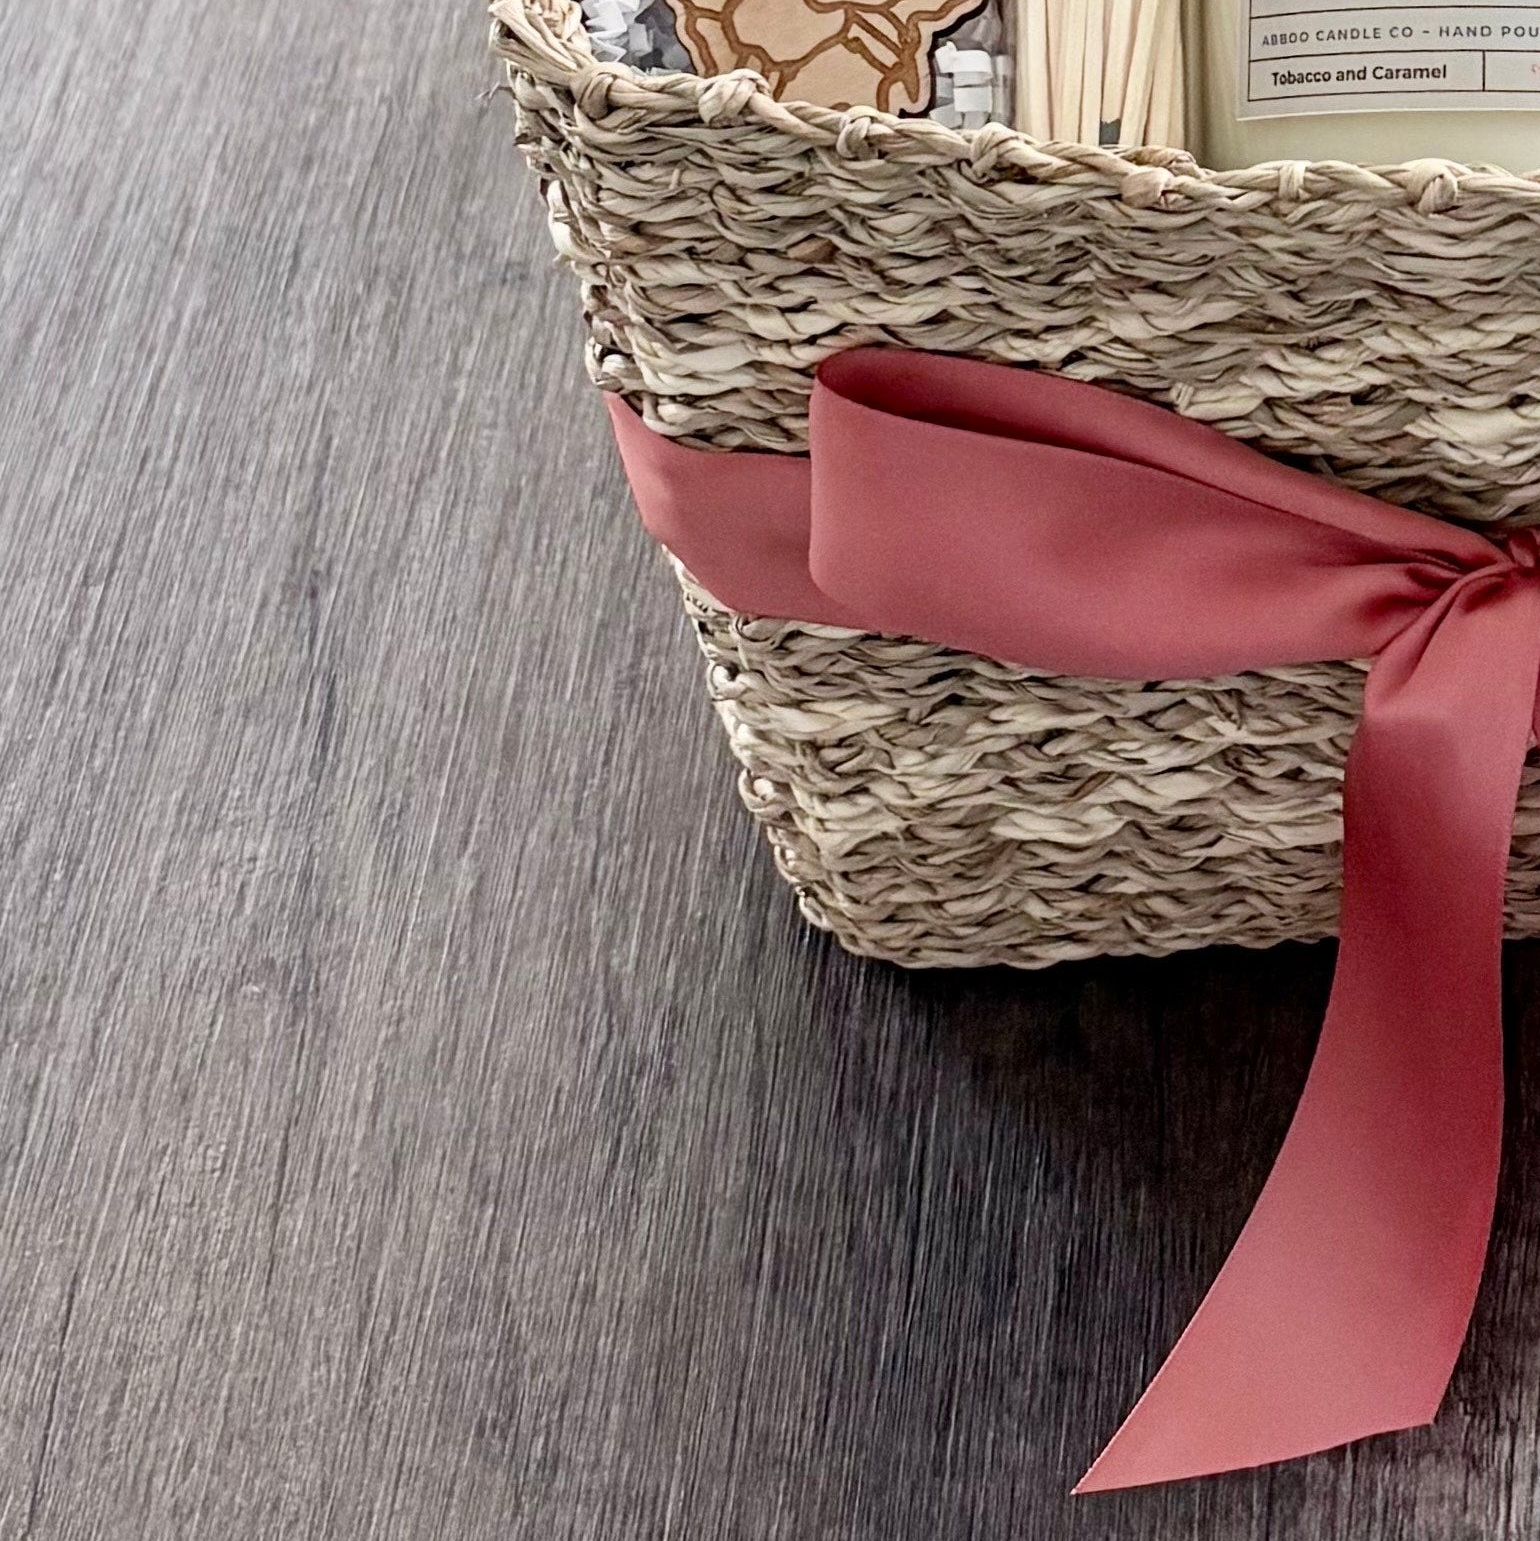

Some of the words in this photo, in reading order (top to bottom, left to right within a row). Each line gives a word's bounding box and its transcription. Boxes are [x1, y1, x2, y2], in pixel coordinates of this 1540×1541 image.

[1316, 27, 1382, 42] CANDLE
[1389, 26, 1413, 38] CO
[1439, 25, 1493, 38] HAND
[1271, 68, 1332, 86] Tobacco
[1335, 66, 1367, 82] and
[1372, 64, 1447, 81] Caramel
